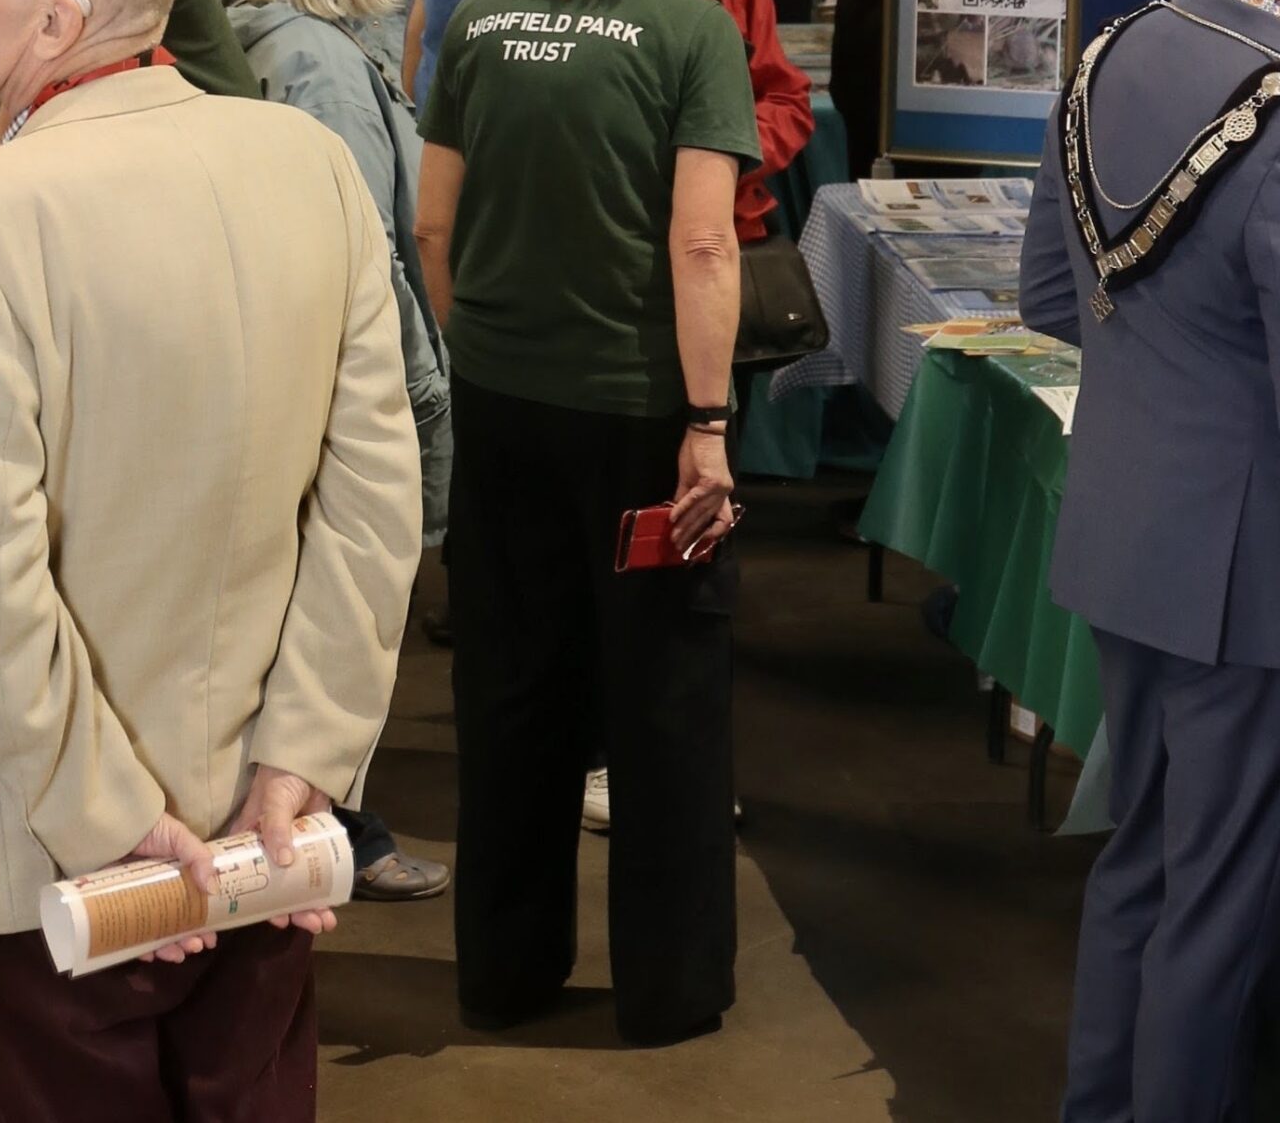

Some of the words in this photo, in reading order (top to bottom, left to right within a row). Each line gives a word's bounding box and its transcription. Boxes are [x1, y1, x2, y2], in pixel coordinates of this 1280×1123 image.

[466, 11, 572, 41] HIGHFIELD
[575, 15, 644, 47] PARK
[502, 40, 576, 62] TRUST
